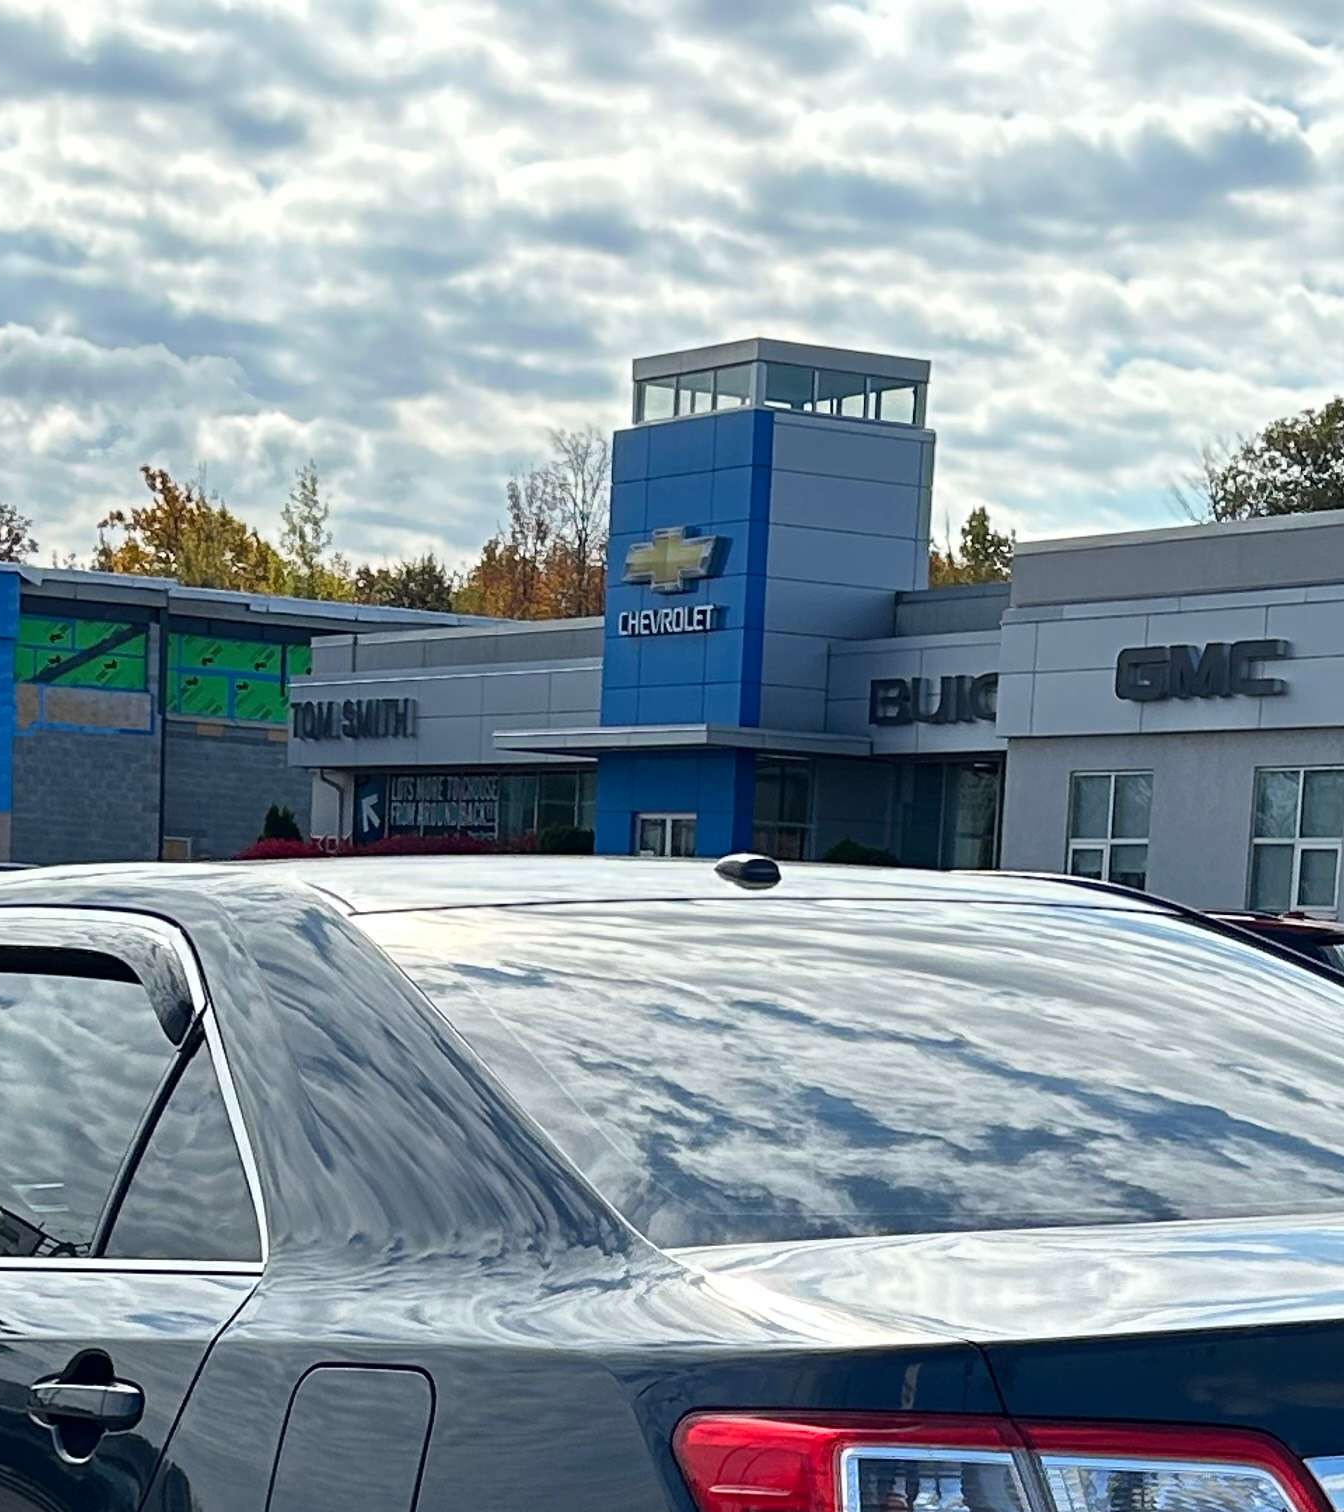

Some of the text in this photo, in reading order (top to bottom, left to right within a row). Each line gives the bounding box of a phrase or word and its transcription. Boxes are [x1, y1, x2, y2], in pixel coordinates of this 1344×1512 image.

[618, 604, 715, 636] CHEVROLET
[1115, 638, 1290, 702] GMC
[290, 698, 418, 741] TOM SMITH
[868, 671, 999, 726] BUIC
